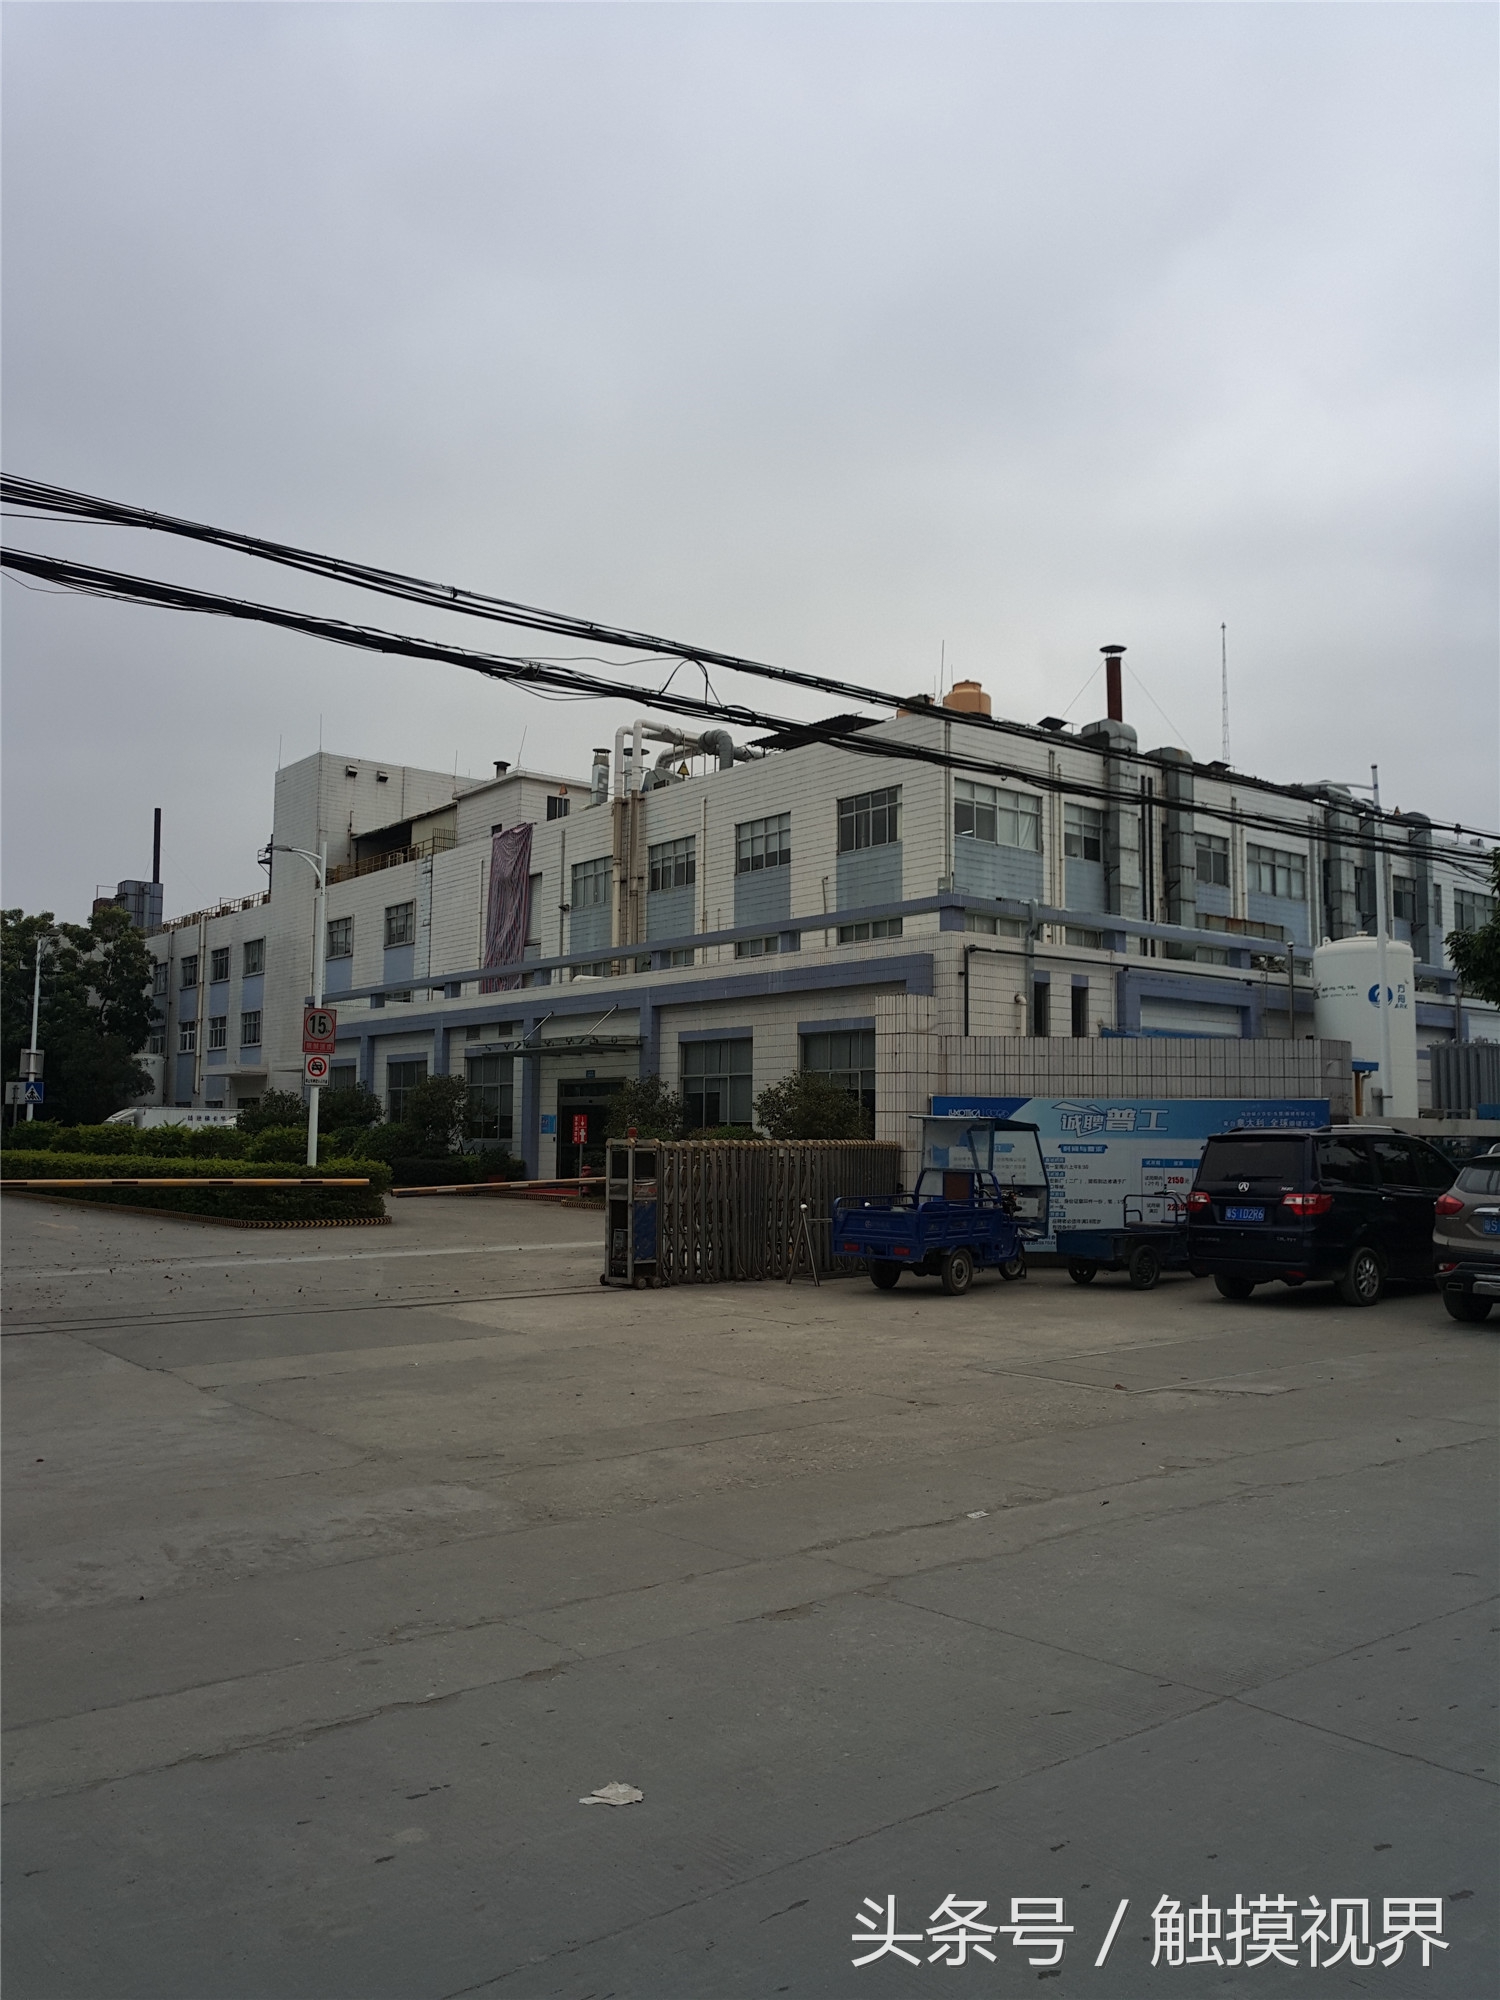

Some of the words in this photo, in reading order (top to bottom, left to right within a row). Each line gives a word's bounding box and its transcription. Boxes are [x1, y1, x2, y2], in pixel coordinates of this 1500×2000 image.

[309, 1015, 326, 1034] 15
[1060, 1107, 1169, 1134] 诚聘普工
